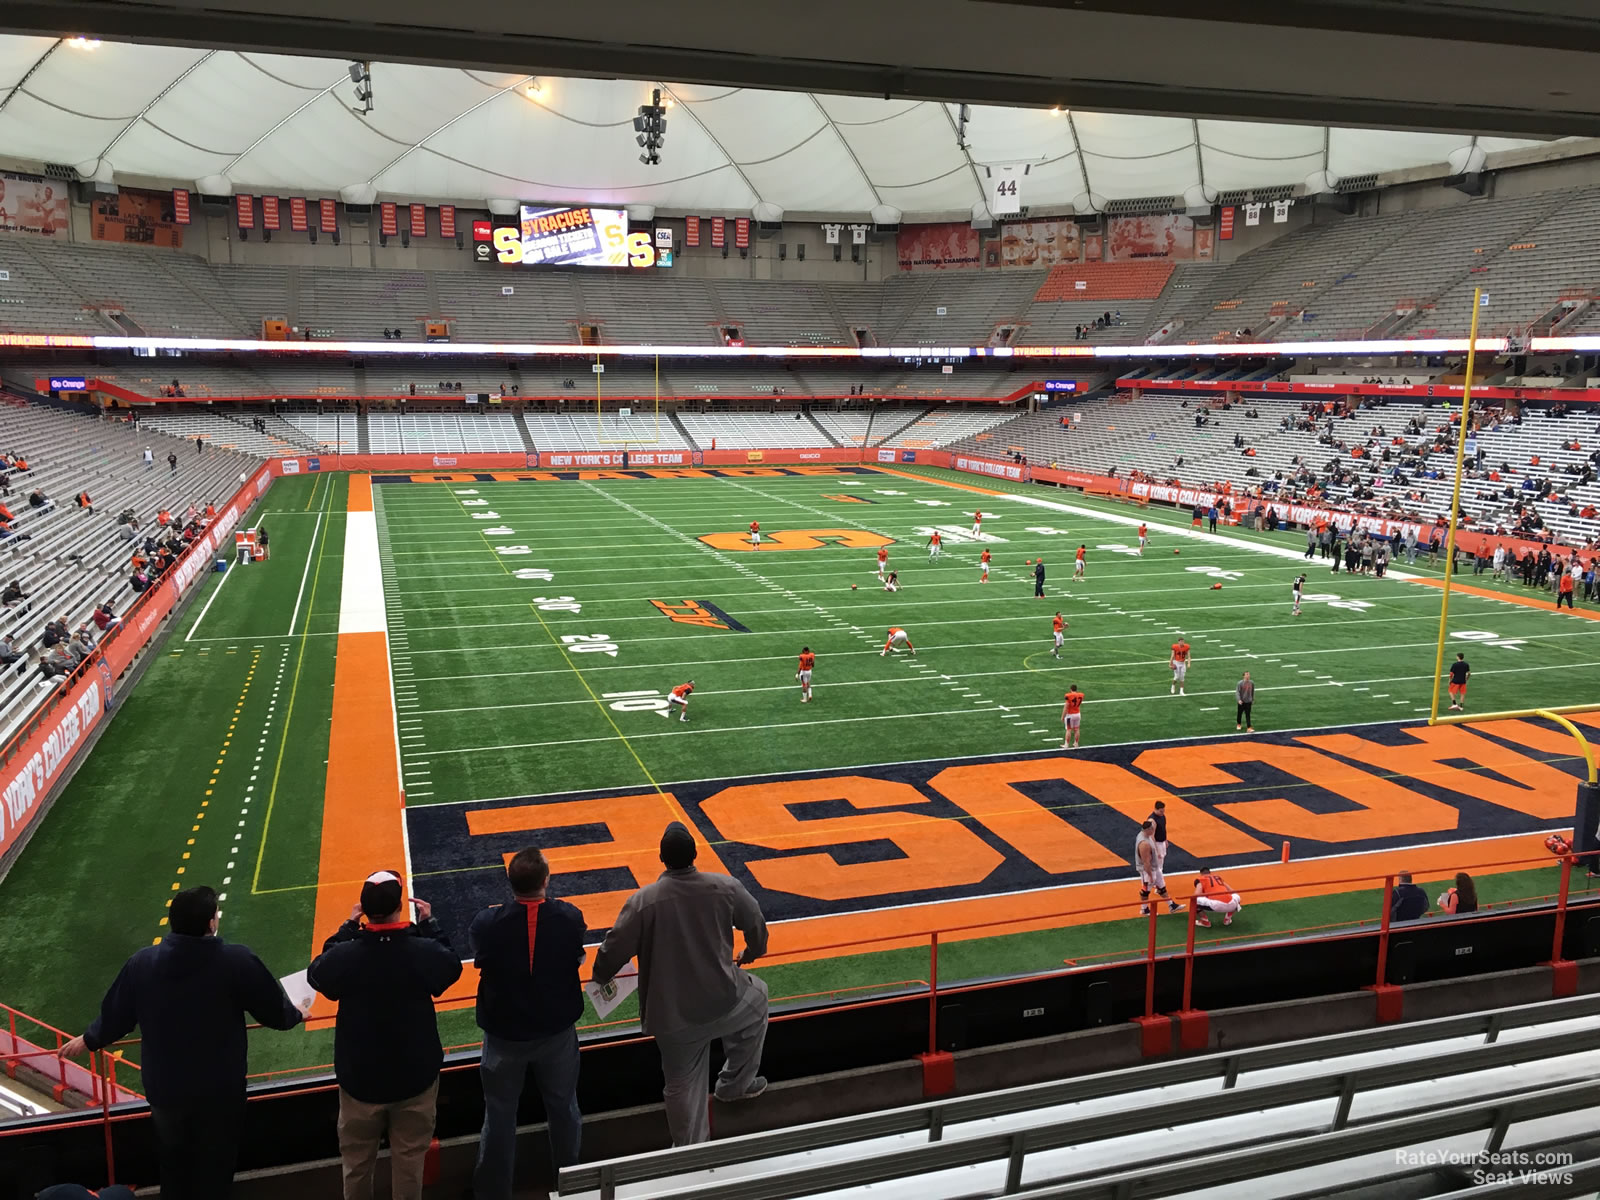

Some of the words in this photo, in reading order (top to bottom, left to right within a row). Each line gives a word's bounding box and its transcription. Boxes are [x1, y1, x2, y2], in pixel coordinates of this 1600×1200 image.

[997, 181, 1017, 196] 44
[521, 208, 592, 236] SYRACUSE
[493, 227, 522, 263] S
[604, 224, 625, 247] S
[627, 232, 655, 267] S
[51, 379, 62, 388] Go
[62, 379, 86, 389] Orange
[1055, 382, 1076, 390] Orange
[550, 455, 573, 466] NEW
[574, 454, 610, 465] YORK'S
[612, 453, 655, 464] COLEGE
[656, 453, 682, 464] TEAM
[410, 466, 855, 483] ORANGE
[985, 463, 1005, 476] COLLEGE
[1006, 466, 1021, 478] TEAM
[1131, 482, 1150, 497] NEW
[1150, 485, 1179, 503] YORK'S
[1179, 489, 1216, 509] COLLEGE
[1331, 514, 1382, 535] COLEGE
[533, 596, 582, 612] 30
[560, 633, 619, 653] 20
[601, 689, 669, 713] 10
[1072, 696, 1082, 707] 47
[3, 752, 45, 829] YORK'S
[42, 704, 81, 780] COLLEGE
[77, 680, 101, 731] TEAM
